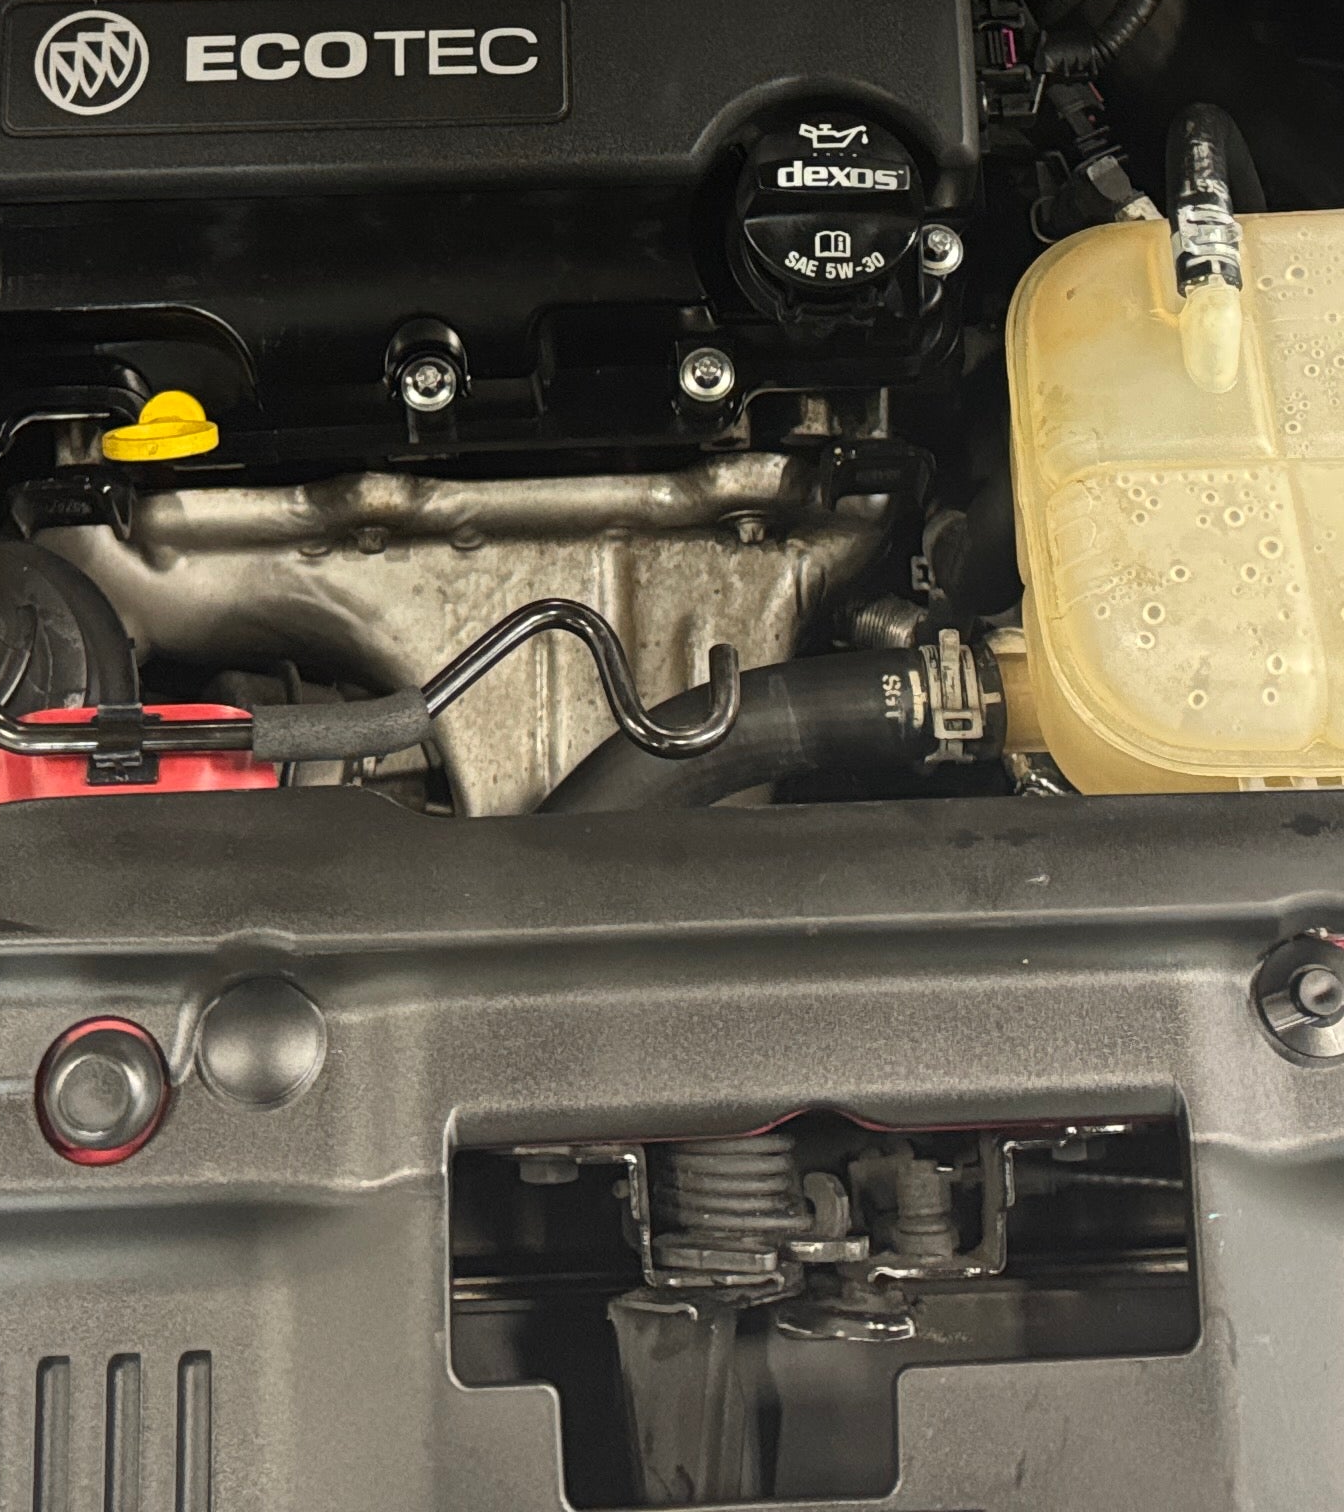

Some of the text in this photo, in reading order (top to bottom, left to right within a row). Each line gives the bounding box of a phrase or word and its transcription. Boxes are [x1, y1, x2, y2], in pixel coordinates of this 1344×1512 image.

[186, 27, 539, 82] ECOTEC
[785, 251, 885, 279] SAE 5W-30
